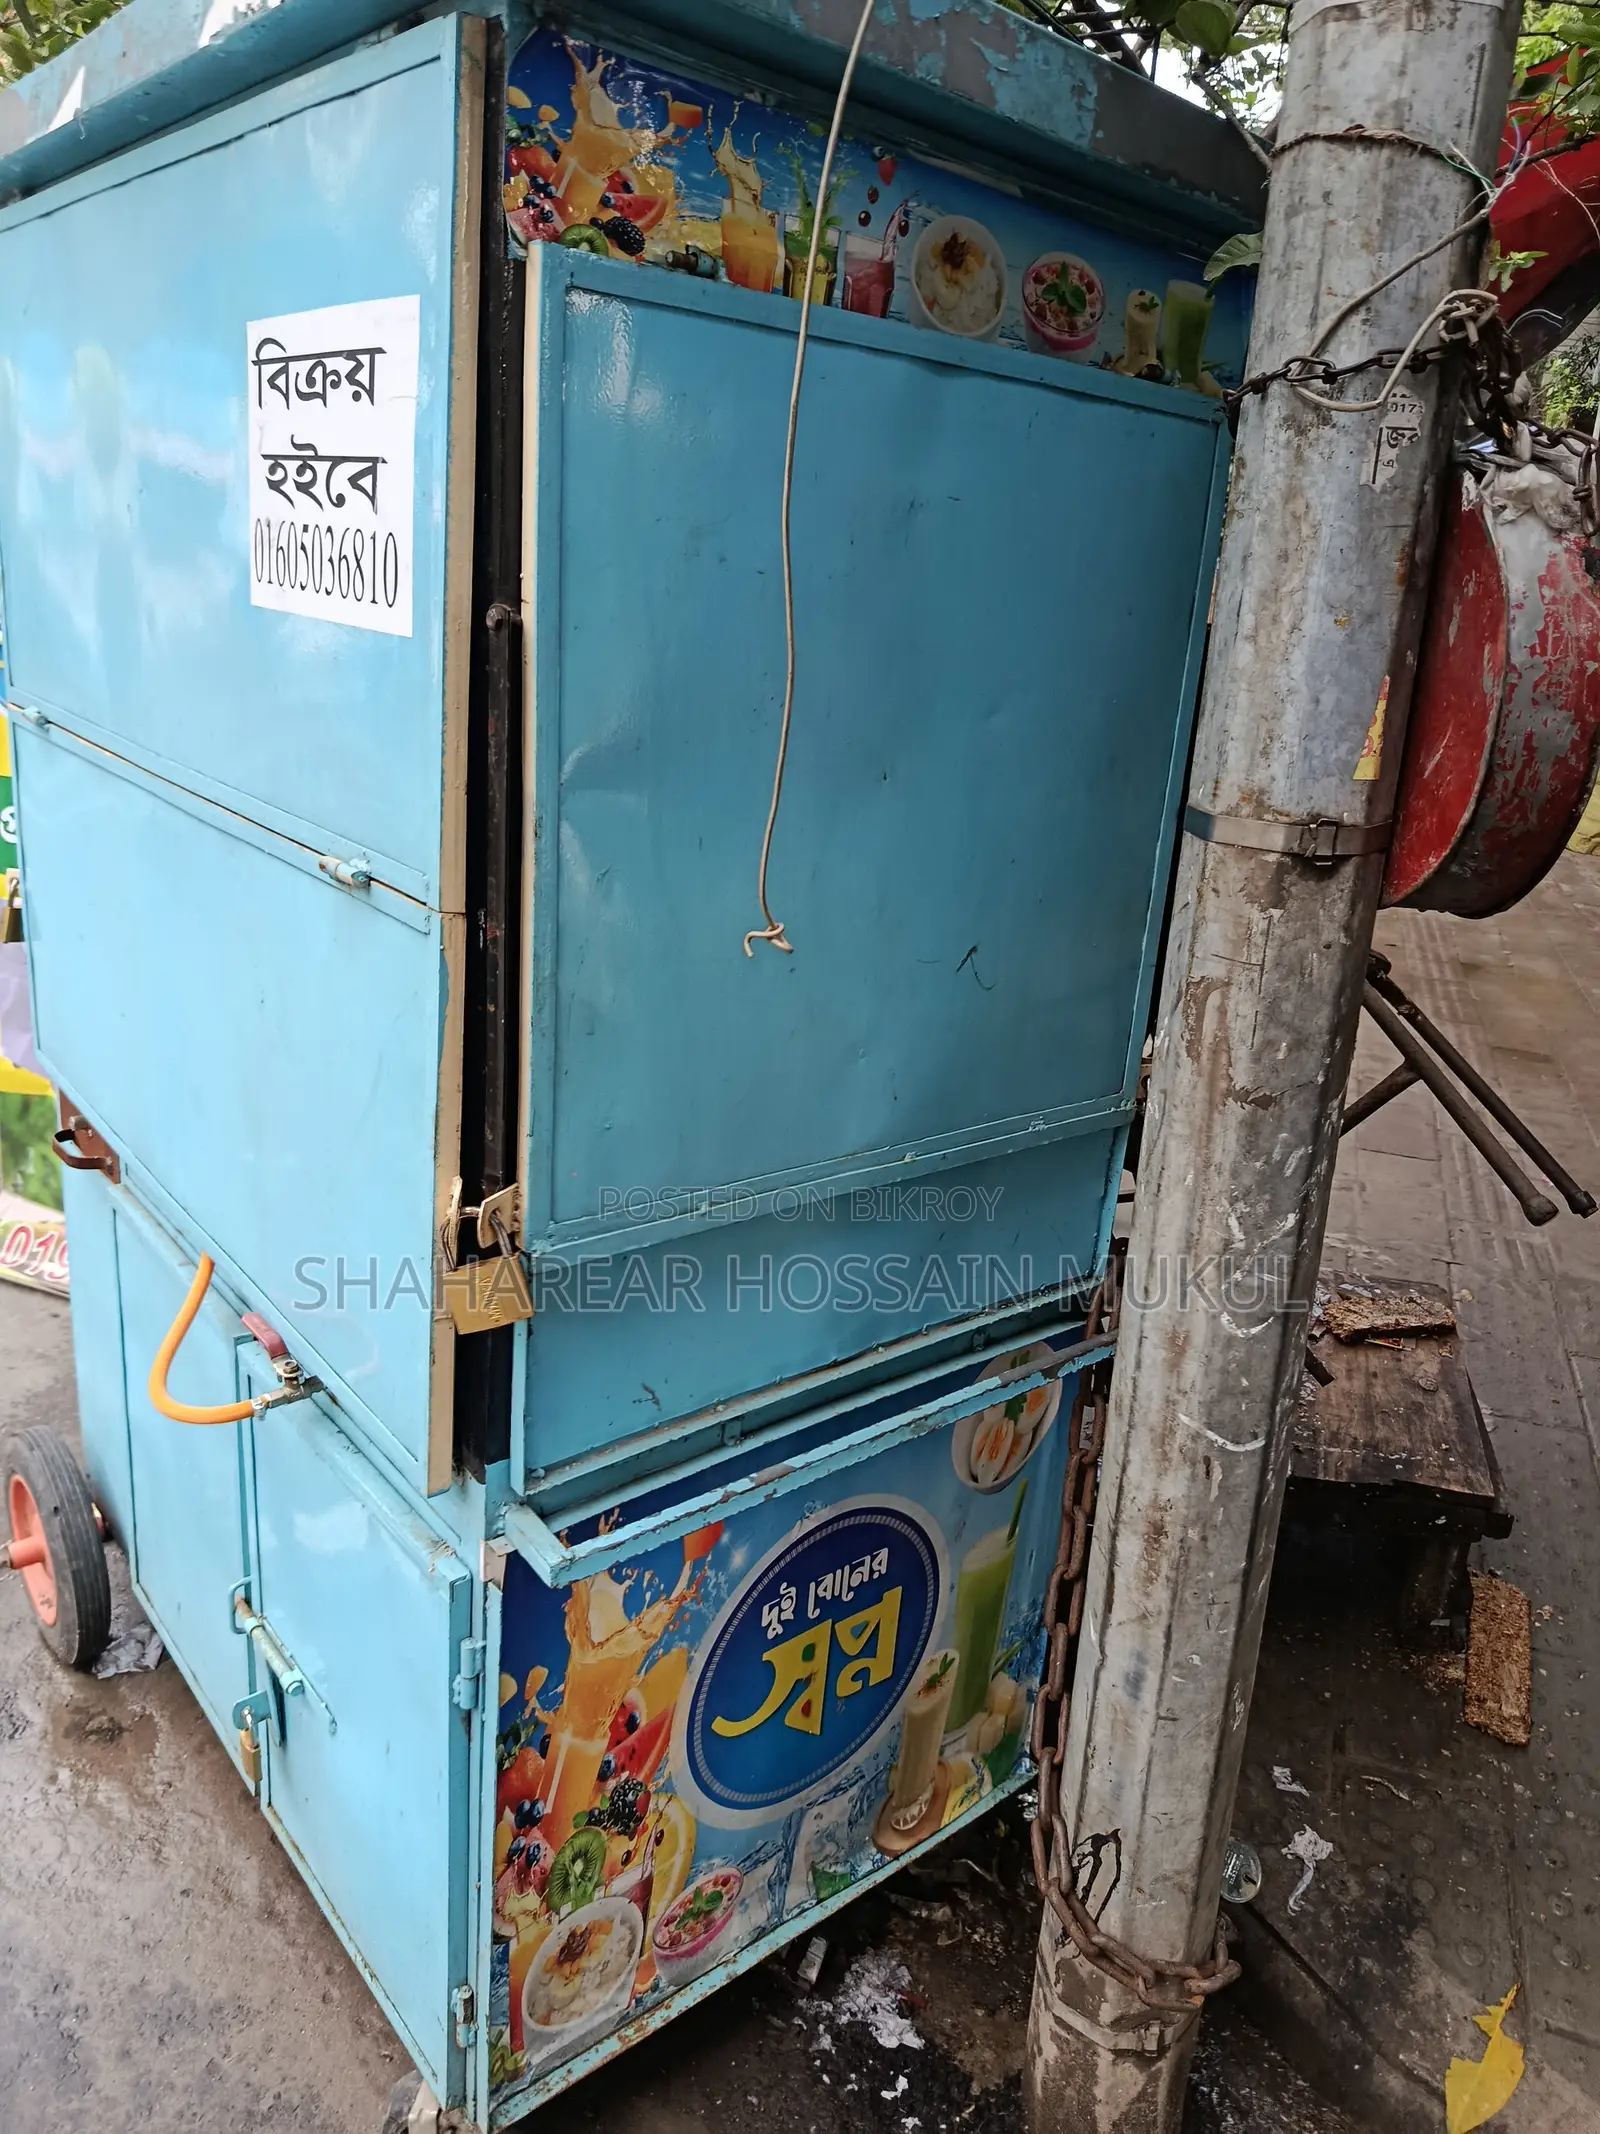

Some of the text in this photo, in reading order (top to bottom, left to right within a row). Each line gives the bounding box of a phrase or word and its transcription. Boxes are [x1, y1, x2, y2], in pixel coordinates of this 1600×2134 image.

[251, 337, 387, 411] বিক্রয়
[261, 434, 388, 516] হইবে
[254, 517, 399, 609] 01605036810
[761, 1547, 889, 1640] দুই বোনের
[710, 1585, 903, 1738] স্বপ্ন
